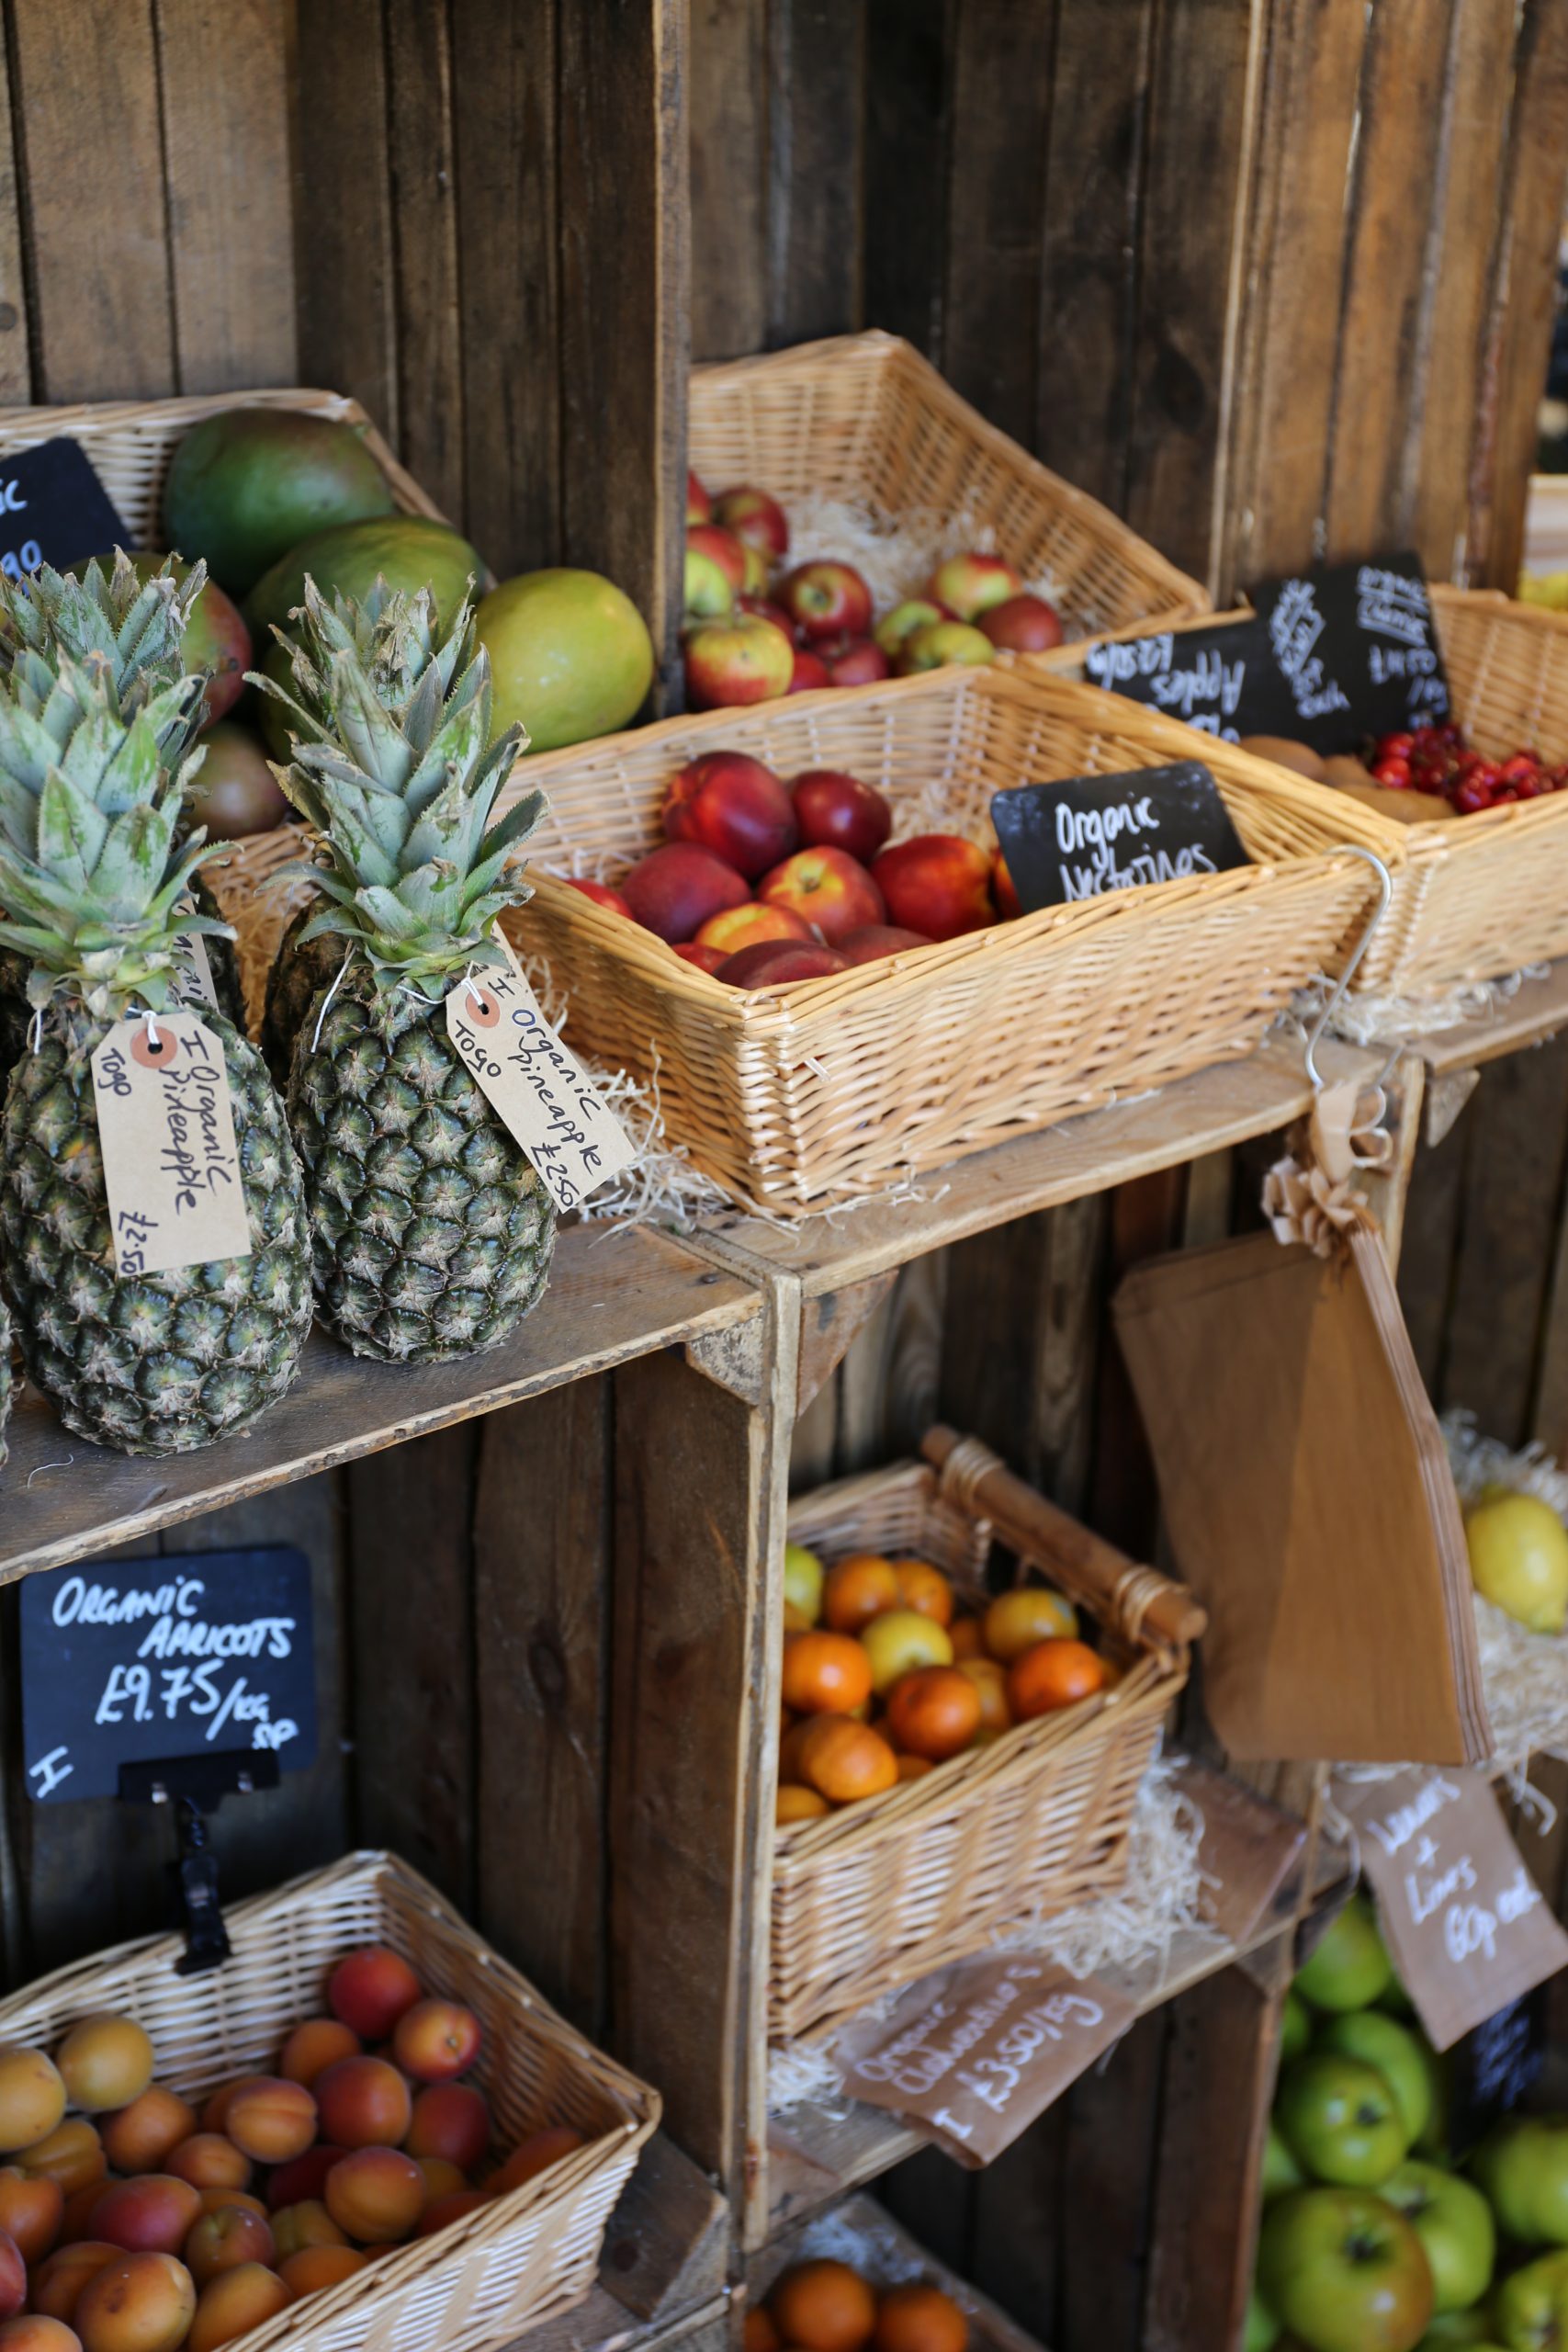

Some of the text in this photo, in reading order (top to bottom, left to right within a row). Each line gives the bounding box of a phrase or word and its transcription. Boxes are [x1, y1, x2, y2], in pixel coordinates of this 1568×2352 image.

[1150, 648, 1247, 717] Apples
[1055, 791, 1160, 871] Organic
[97, 1047, 132, 1097] Togo
[455, 1019, 502, 1078] Togo
[512, 1009, 602, 1121] Organic
[186, 1066, 231, 1197] Organic
[530, 1142, 581, 1207] £2.50
[118, 1211, 159, 1276] £2.50
[853, 2002, 956, 2081] Organic
